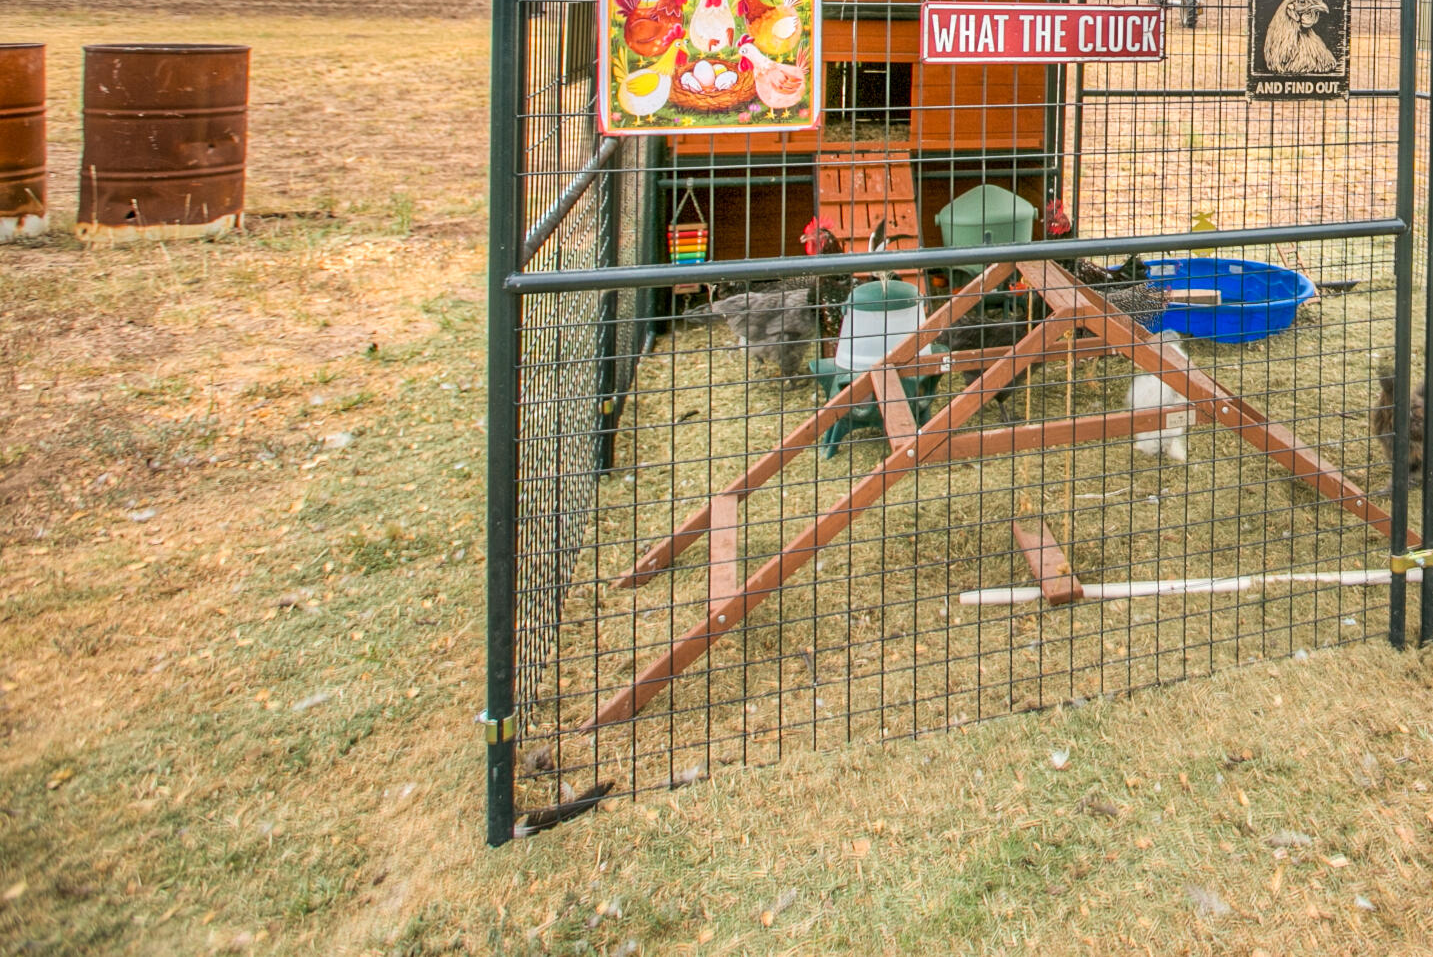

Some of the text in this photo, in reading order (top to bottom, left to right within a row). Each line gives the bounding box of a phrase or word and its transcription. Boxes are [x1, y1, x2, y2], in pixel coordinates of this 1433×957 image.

[932, 13, 1158, 53] WHAT THE CLUCK
[1256, 81, 1339, 94] AND FIND OUT
